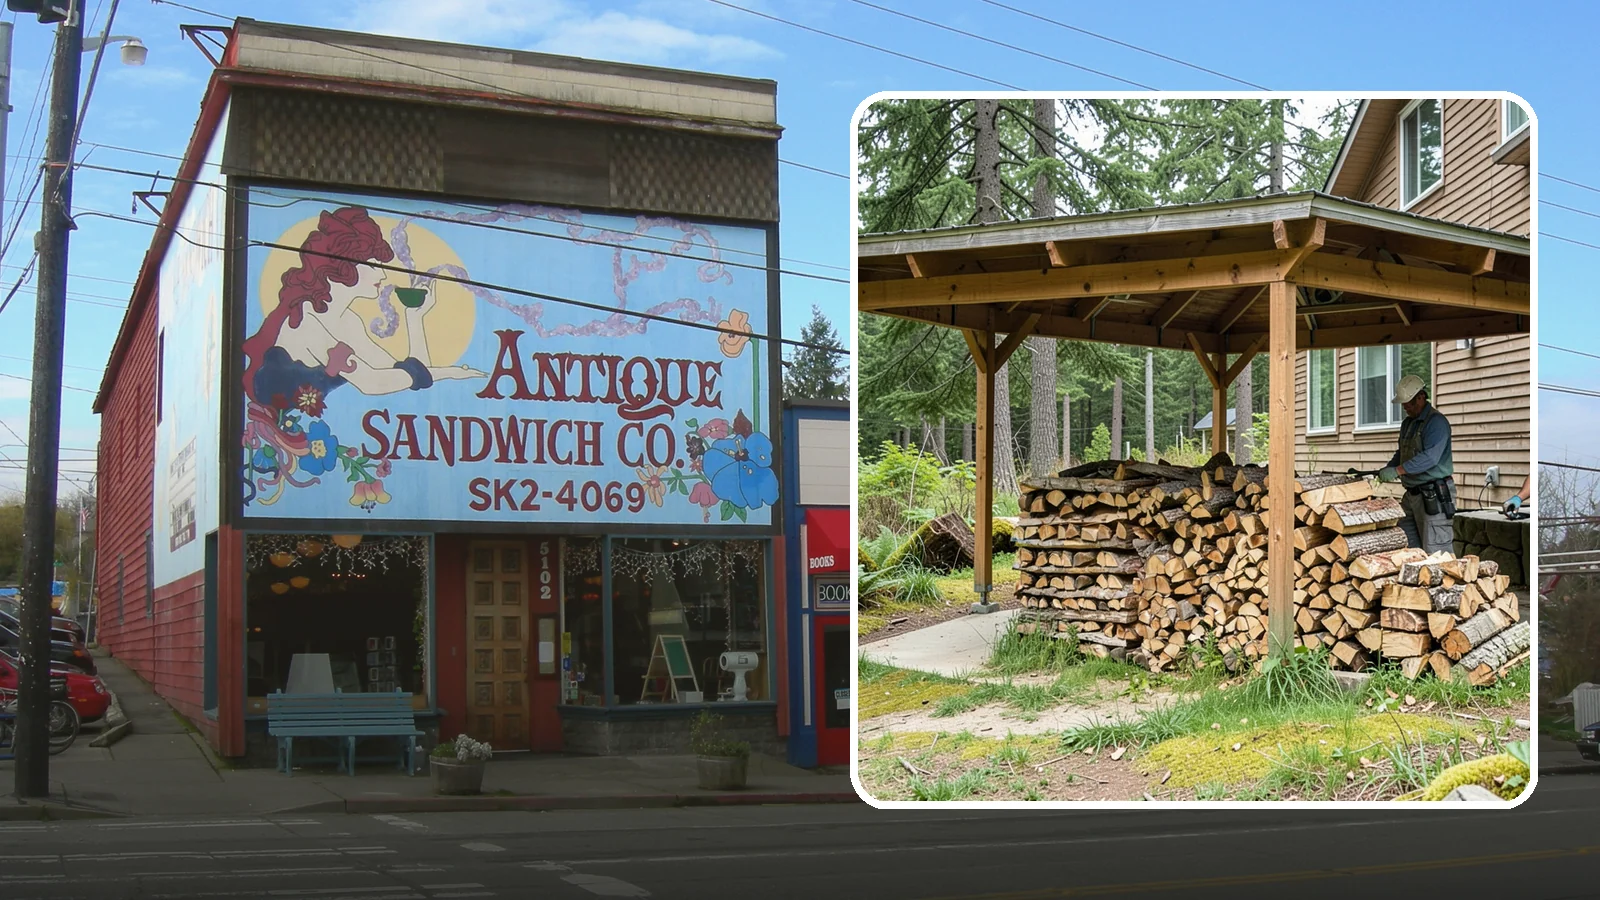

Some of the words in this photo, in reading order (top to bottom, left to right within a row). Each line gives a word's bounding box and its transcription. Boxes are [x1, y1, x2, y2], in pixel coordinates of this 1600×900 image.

[477, 329, 724, 421] ANTIQUE
[362, 408, 605, 467] SANDWICH
[616, 420, 686, 469] CO.
[468, 477, 646, 512] SK2-4069
[539, 541, 552, 600] 5102
[809, 555, 835, 569] BOOKS
